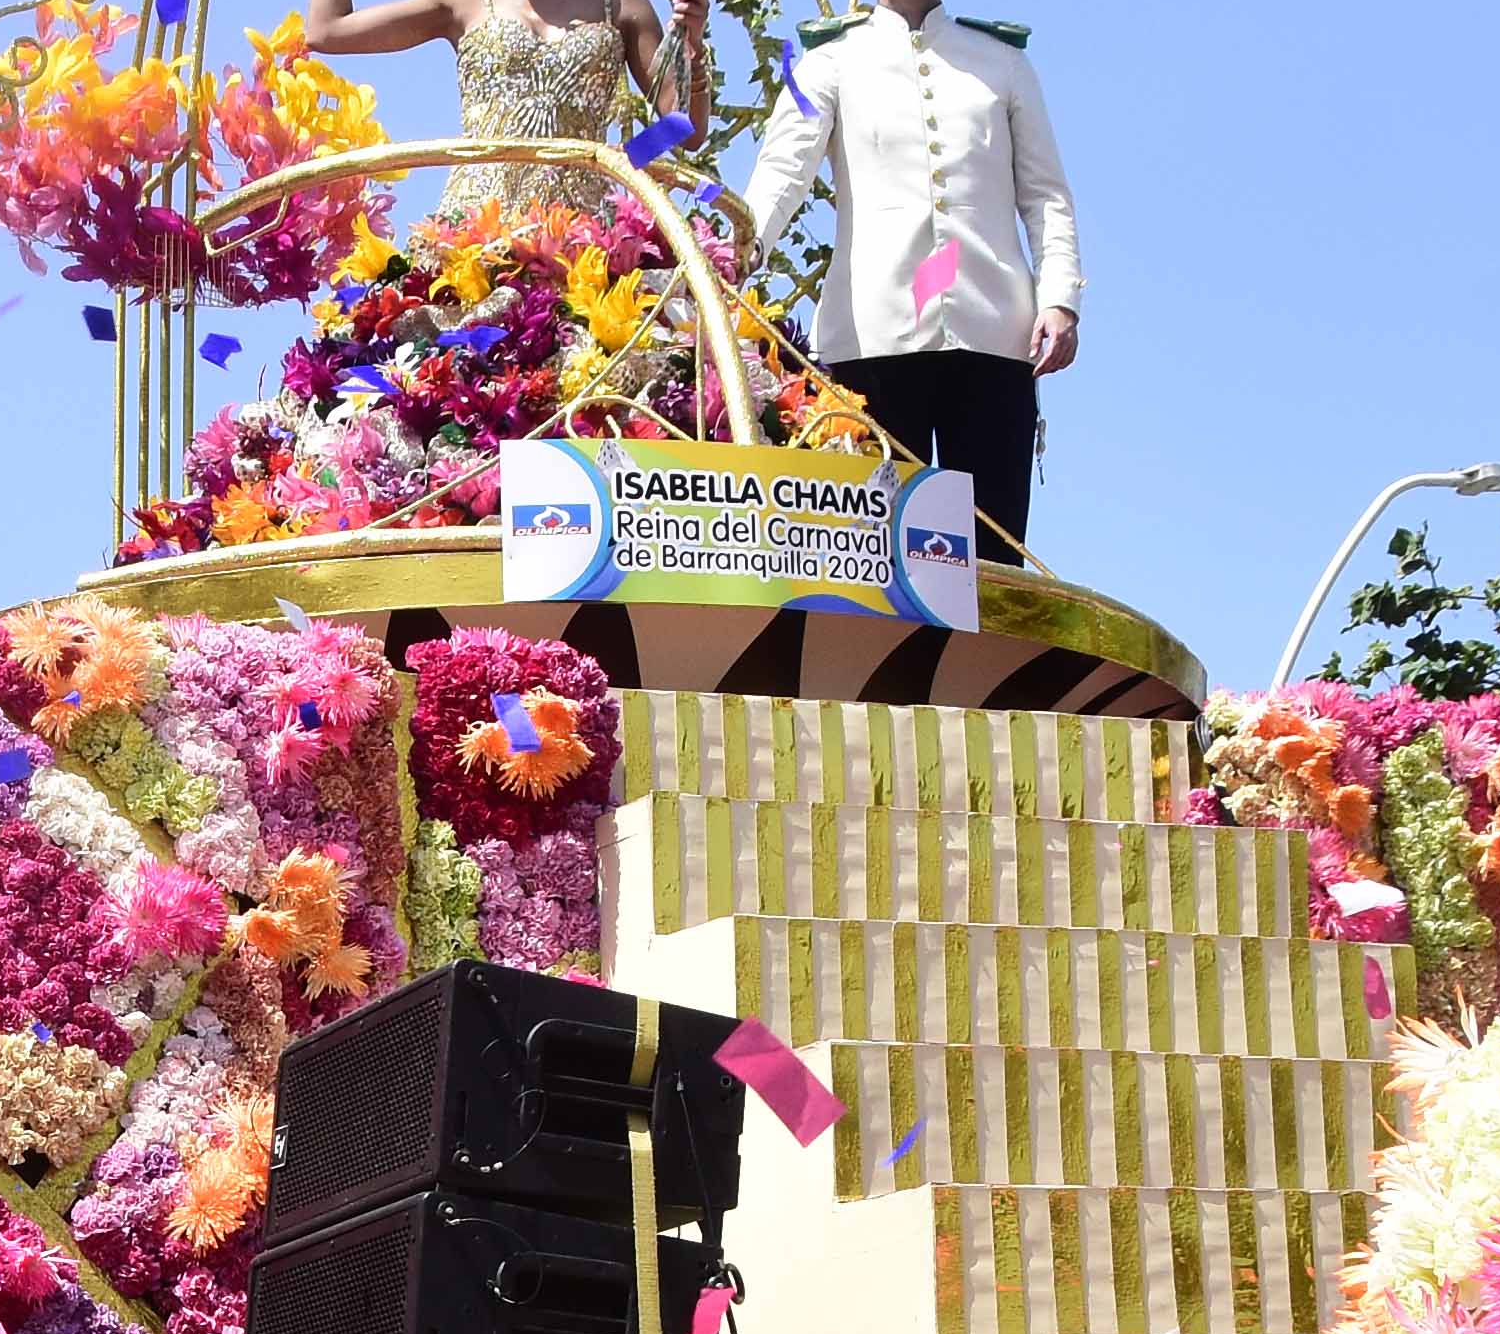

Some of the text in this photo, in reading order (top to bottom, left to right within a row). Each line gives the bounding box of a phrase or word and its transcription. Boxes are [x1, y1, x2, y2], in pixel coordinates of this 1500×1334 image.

[615, 472, 888, 518] ISABELLA CHAMS
[515, 526, 589, 537] OLIMPICA
[617, 511, 888, 557] Reina del Carnaval
[616, 542, 890, 584] de Barranquilla 2020
[909, 550, 967, 566] OLIMPICA
